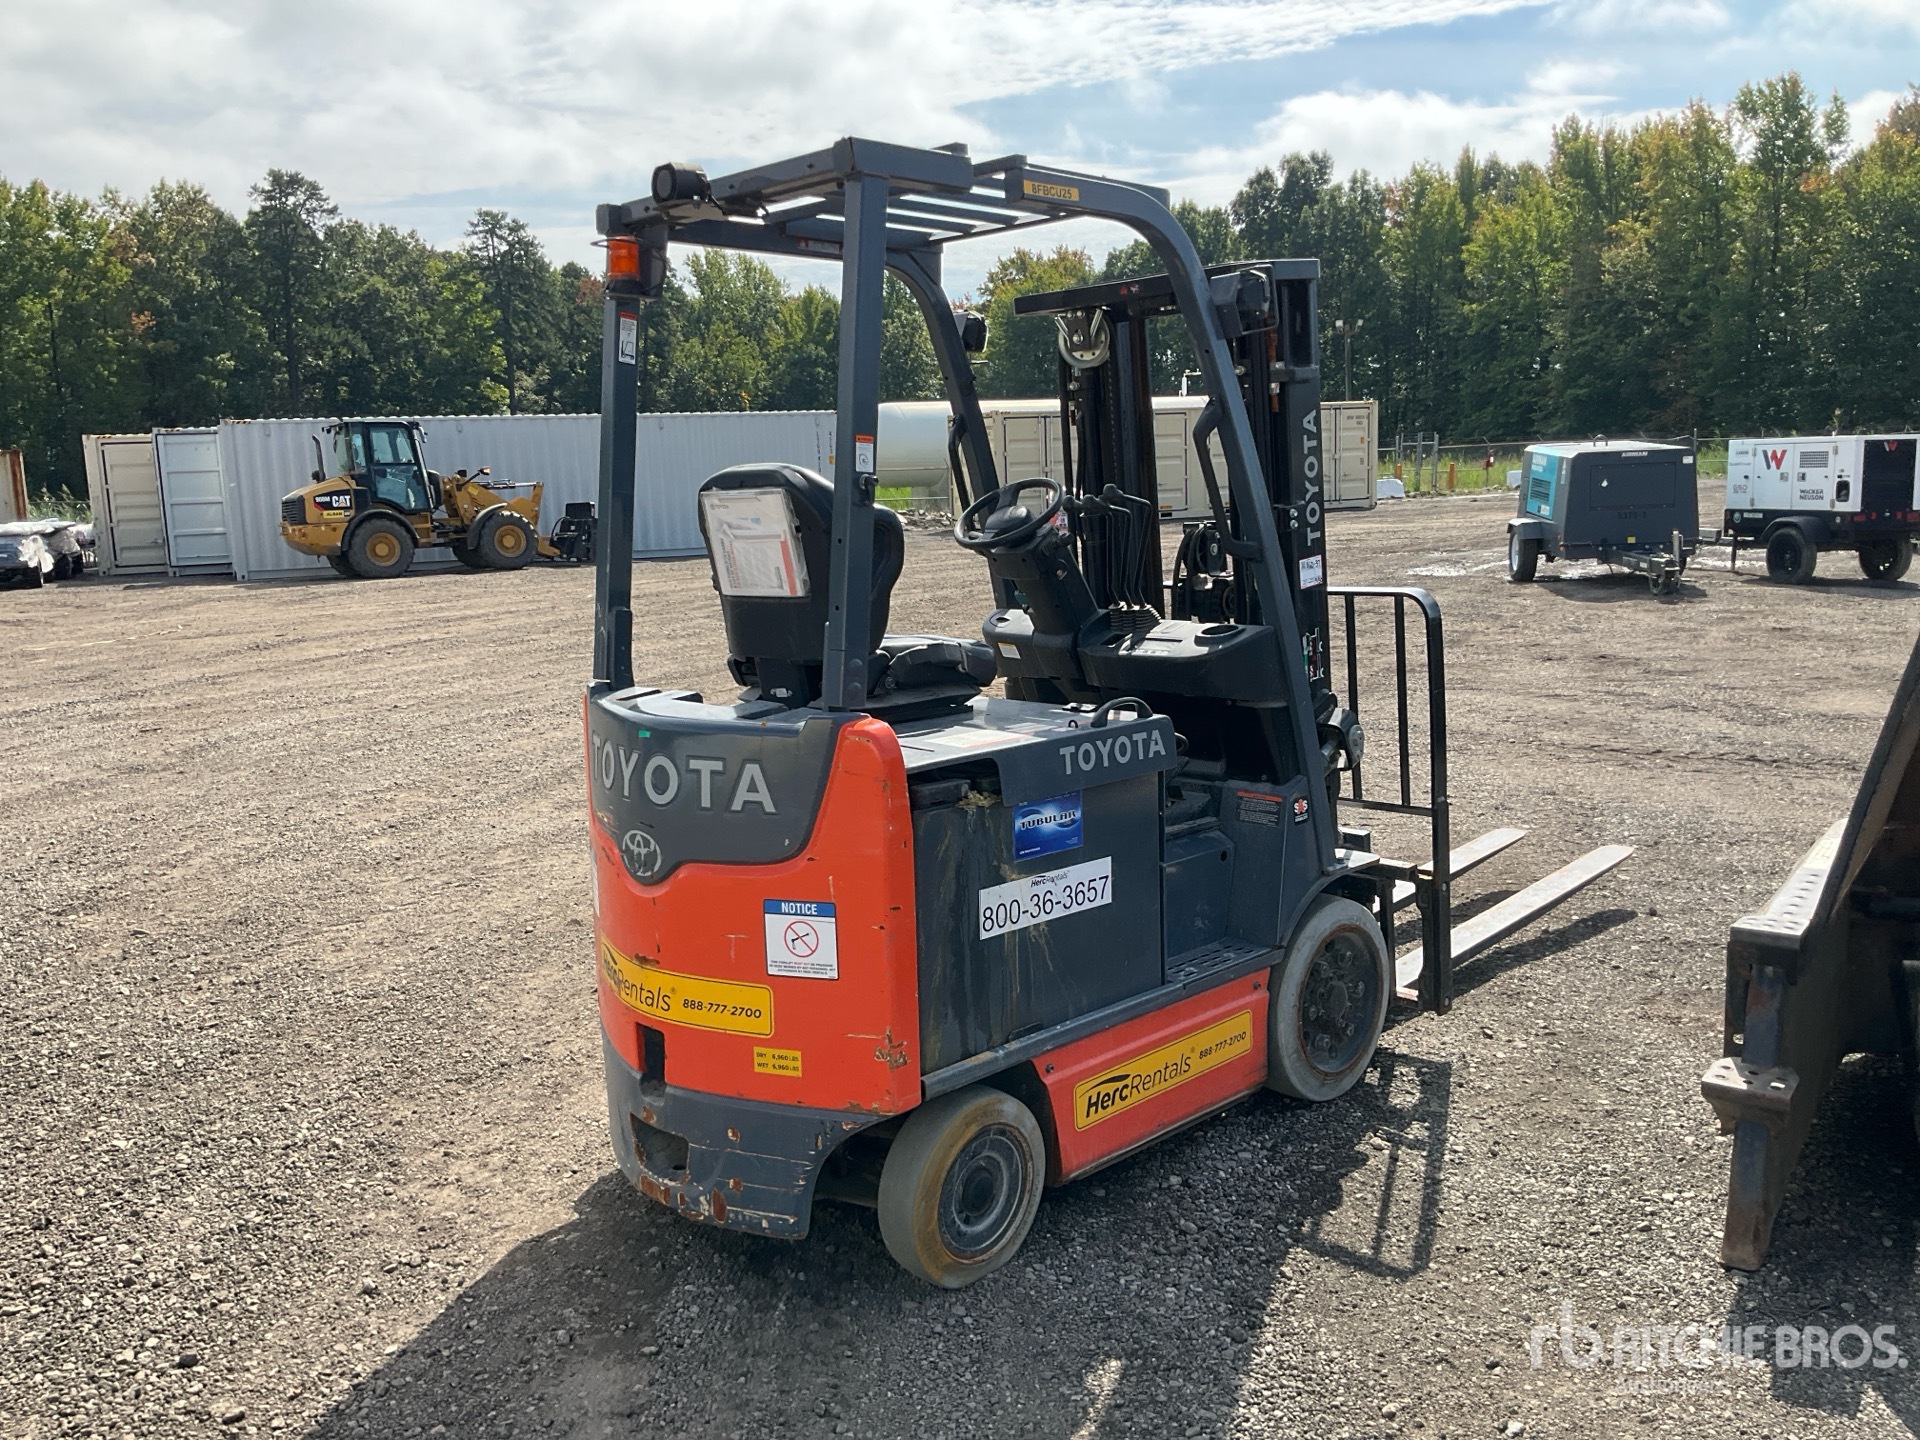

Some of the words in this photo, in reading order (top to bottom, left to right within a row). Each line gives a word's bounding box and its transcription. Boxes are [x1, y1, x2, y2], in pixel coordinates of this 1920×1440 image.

[1031, 183, 1073, 200] 8FBCU25
[1302, 409, 1321, 547] TOYOTA
[332, 495, 350, 507] CAT
[1059, 729, 1166, 775] TOYOTA
[592, 733, 777, 812] TOYOTA
[1020, 809, 1077, 830] TUBULAR
[781, 902, 818, 915] NOTICE
[982, 874, 1110, 932] 800-36-3657
[682, 998, 762, 1019] 888-777-2700
[1085, 1053, 1191, 1119] HercRentals
[1198, 1031, 1247, 1060] 888-777-2700
